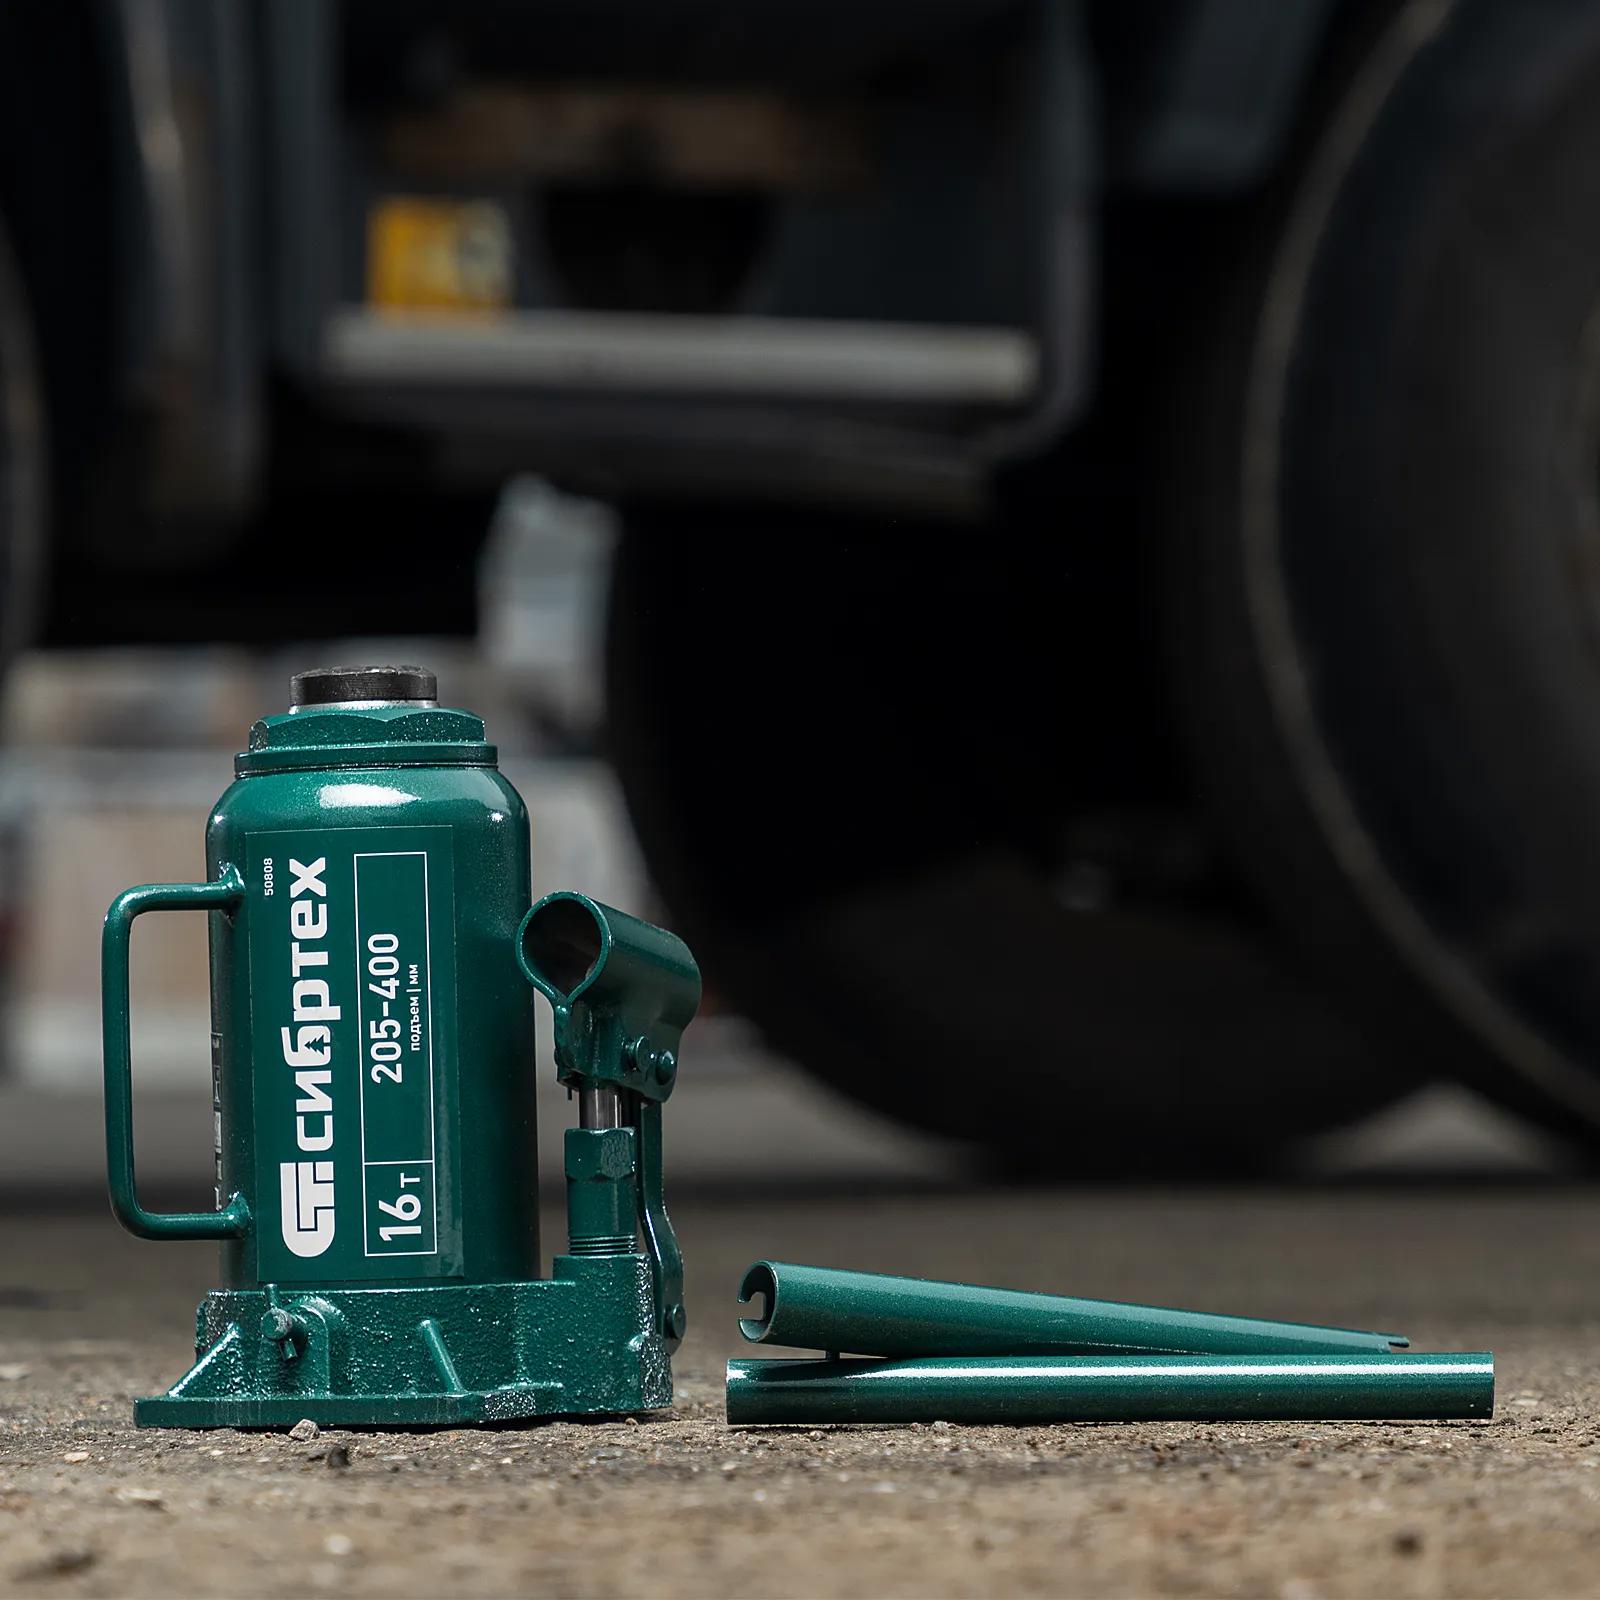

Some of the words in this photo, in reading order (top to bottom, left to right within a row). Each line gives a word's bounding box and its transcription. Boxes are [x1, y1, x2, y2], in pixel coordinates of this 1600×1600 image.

[263, 857, 274, 897] 50808
[408, 964, 419, 985] мм
[367, 933, 402, 1084] 205-400
[408, 996, 422, 1052] подъем
[378, 1194, 422, 1242] 16
